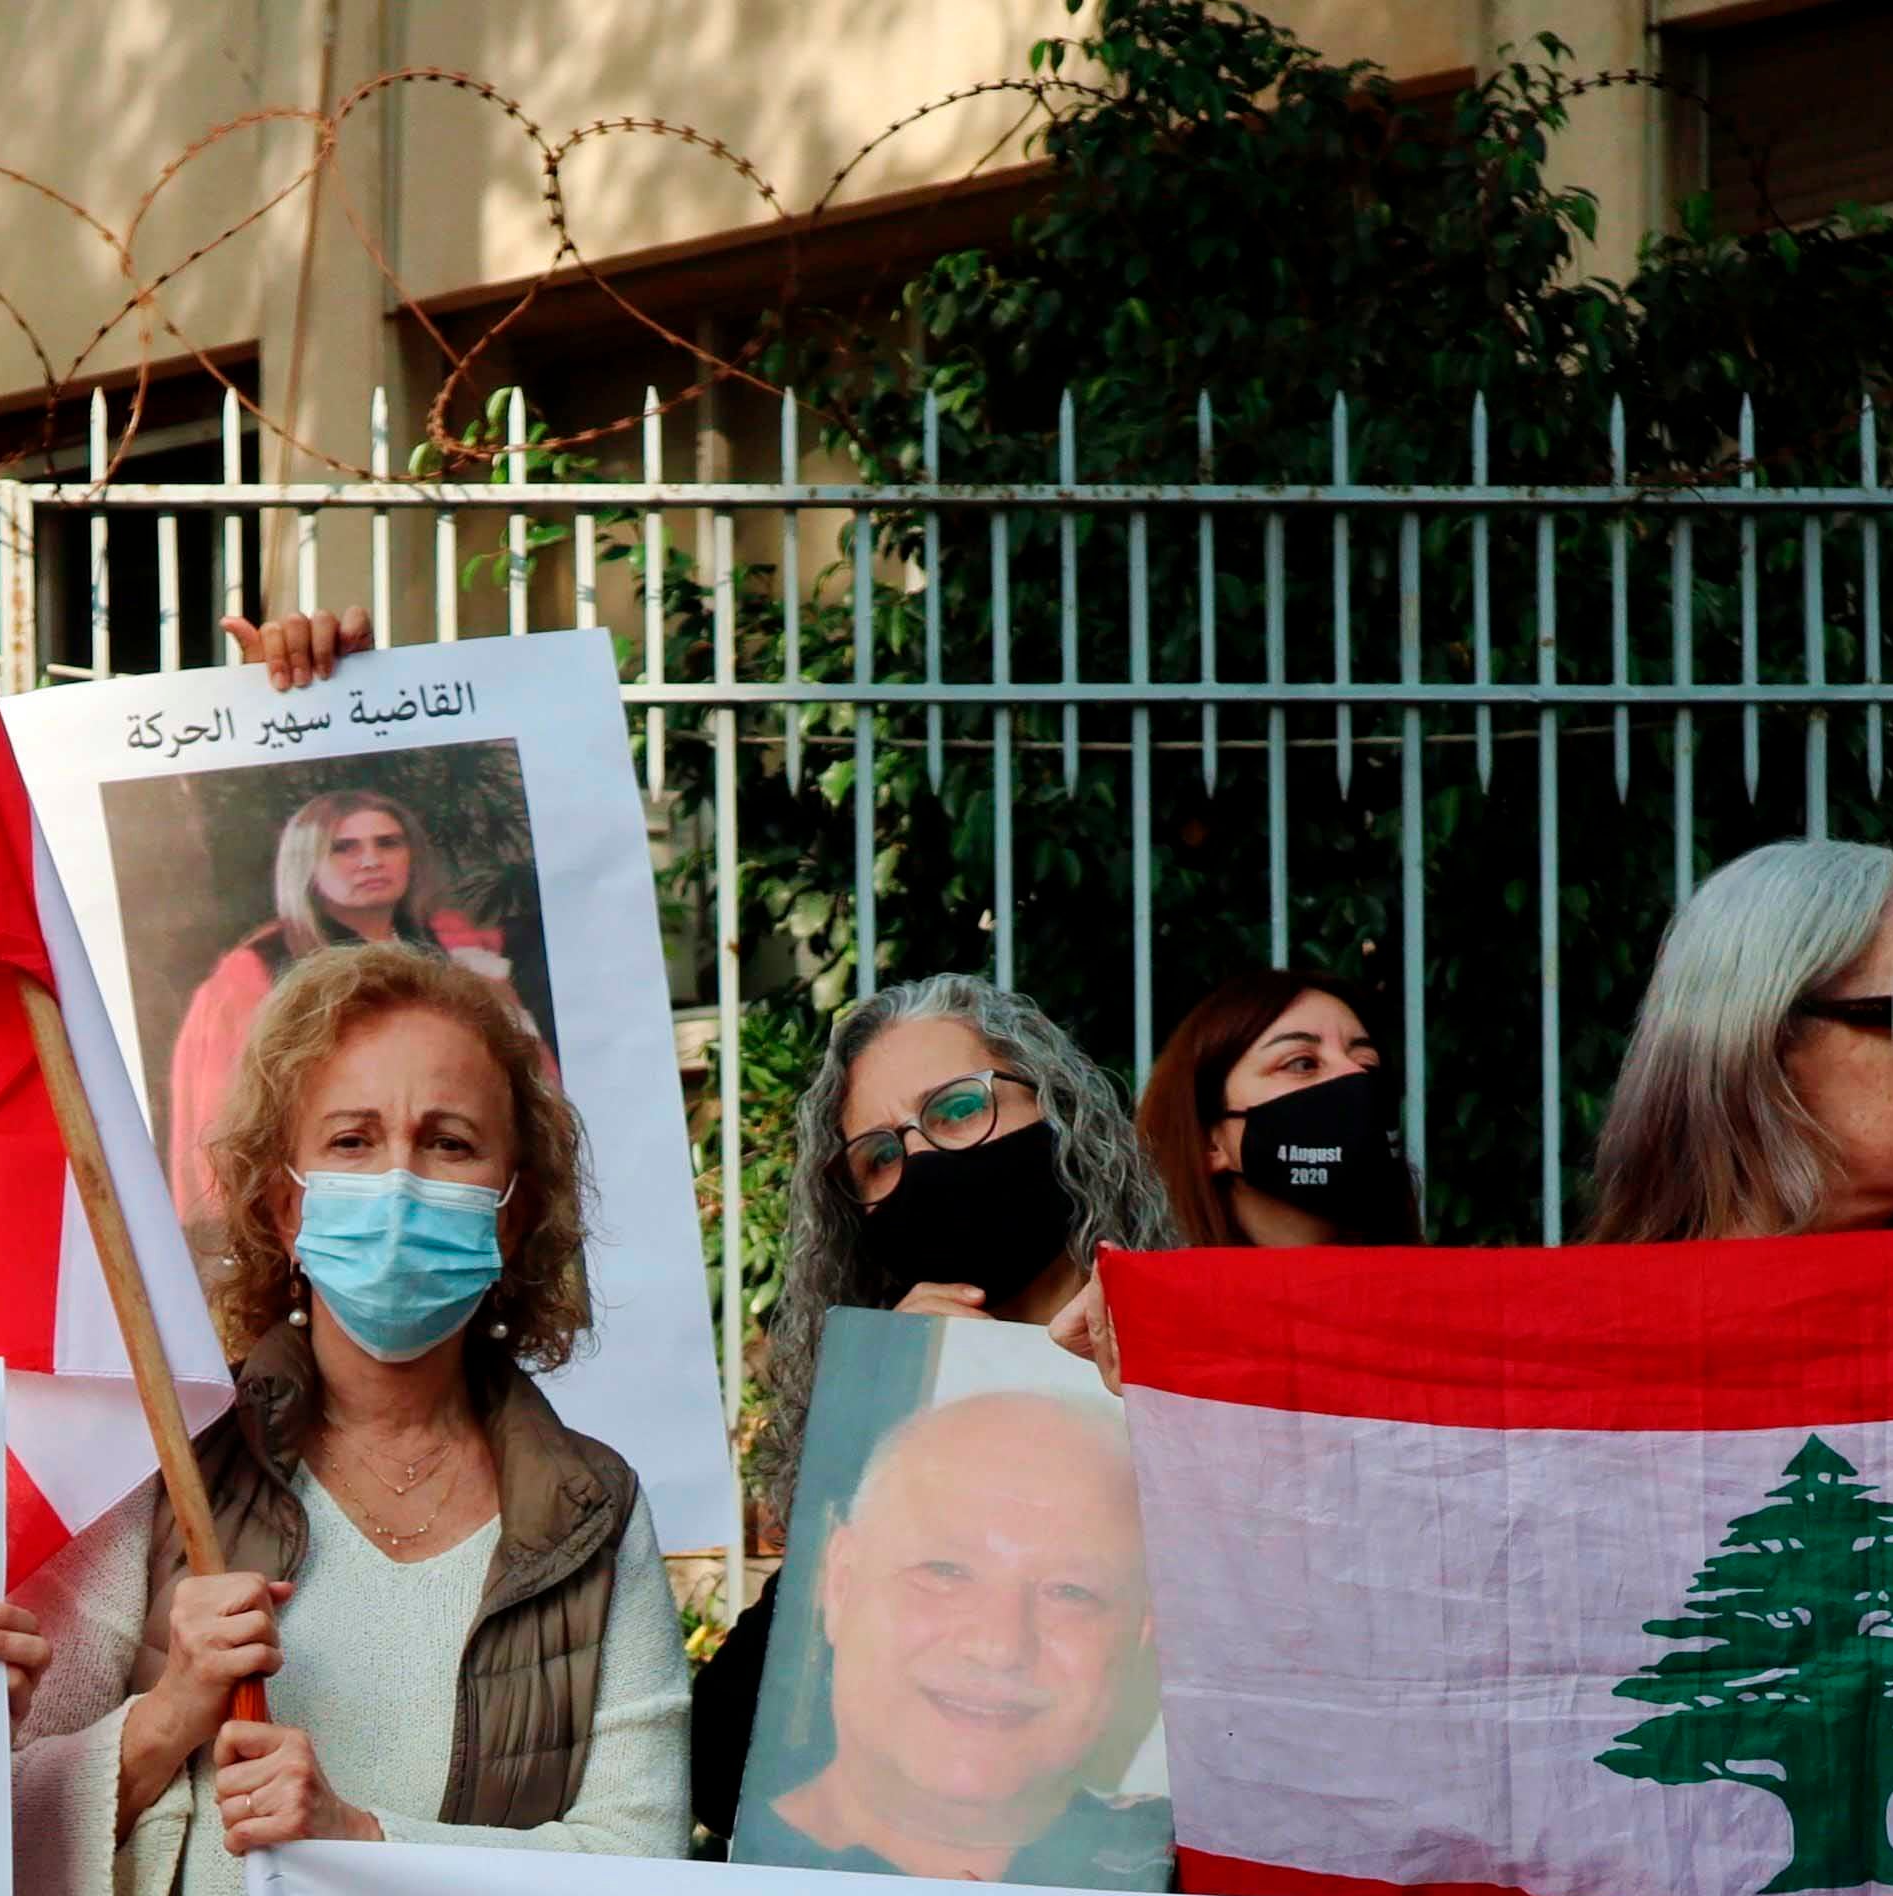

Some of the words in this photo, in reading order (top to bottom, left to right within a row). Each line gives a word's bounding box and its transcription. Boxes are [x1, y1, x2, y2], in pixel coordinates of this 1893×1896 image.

[350, 682, 475, 736] القاضية
[128, 707, 235, 758] الحركة
[256, 712, 331, 749] سهير
[1278, 1146, 1286, 1160] 4
[1290, 1146, 1341, 1163] August
[1292, 1168, 1327, 1184] 2020
